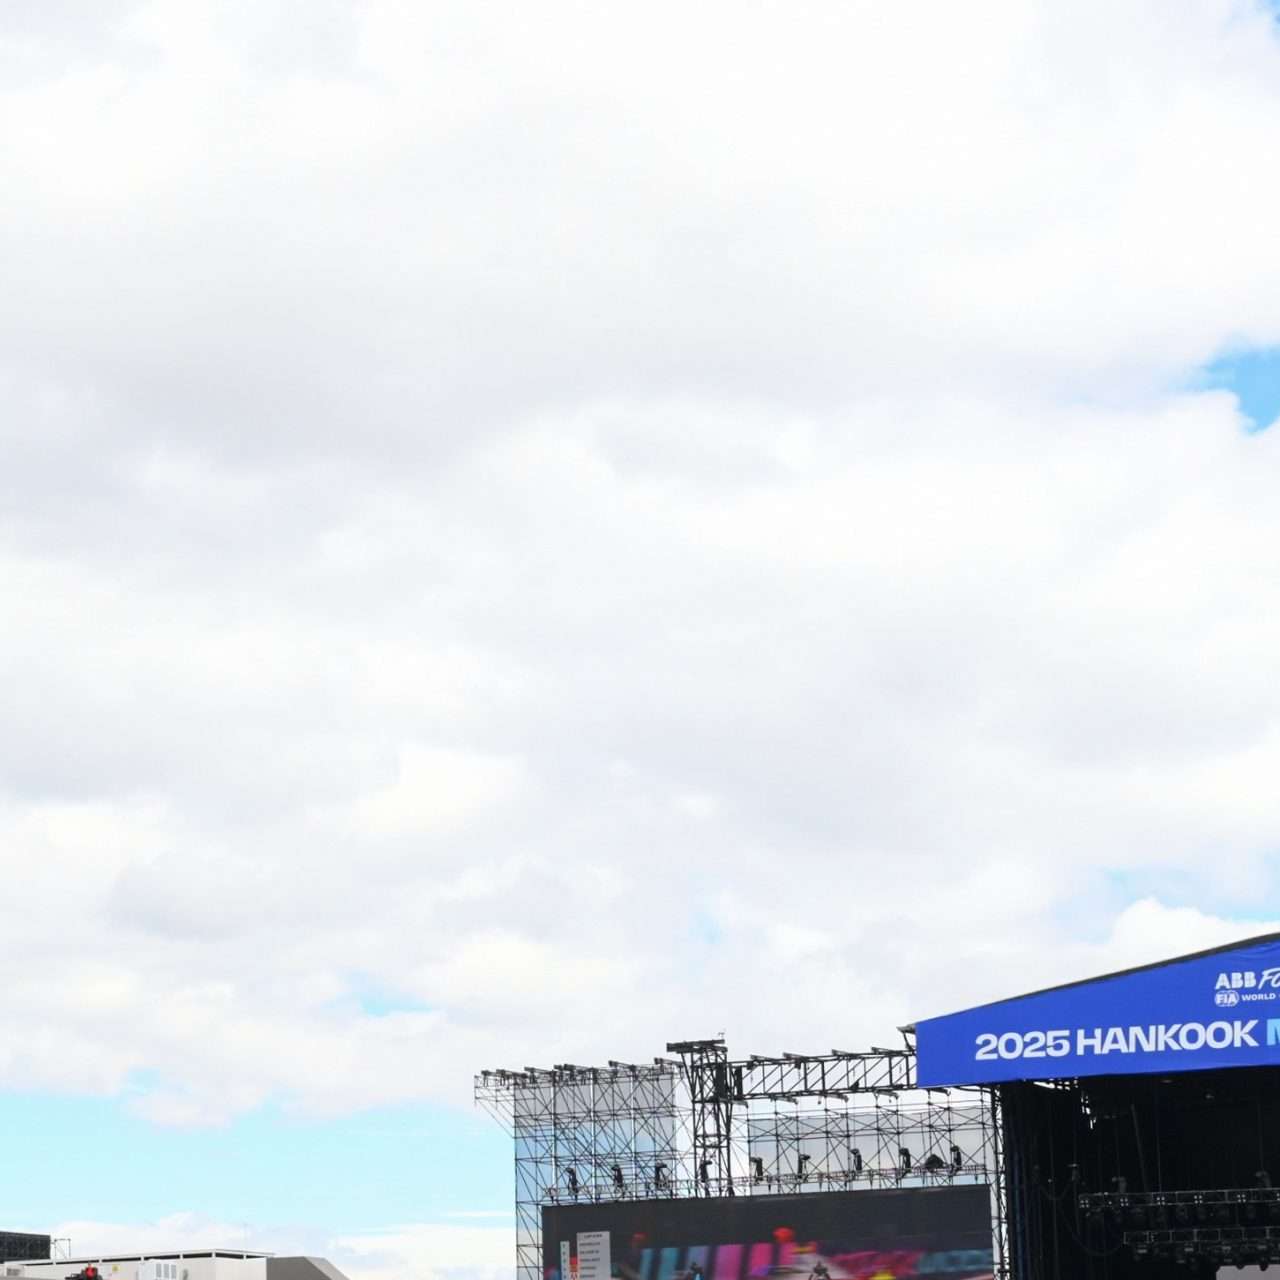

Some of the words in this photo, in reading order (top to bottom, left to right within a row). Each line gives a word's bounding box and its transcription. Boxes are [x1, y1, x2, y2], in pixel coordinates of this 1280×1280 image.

[1215, 971, 1256, 990] ABB
[1215, 991, 1239, 1006] FIA
[1241, 992, 1276, 1001] WORLD
[975, 1030, 1070, 1060] 2025
[1077, 1019, 1259, 1056] HANKOOK
